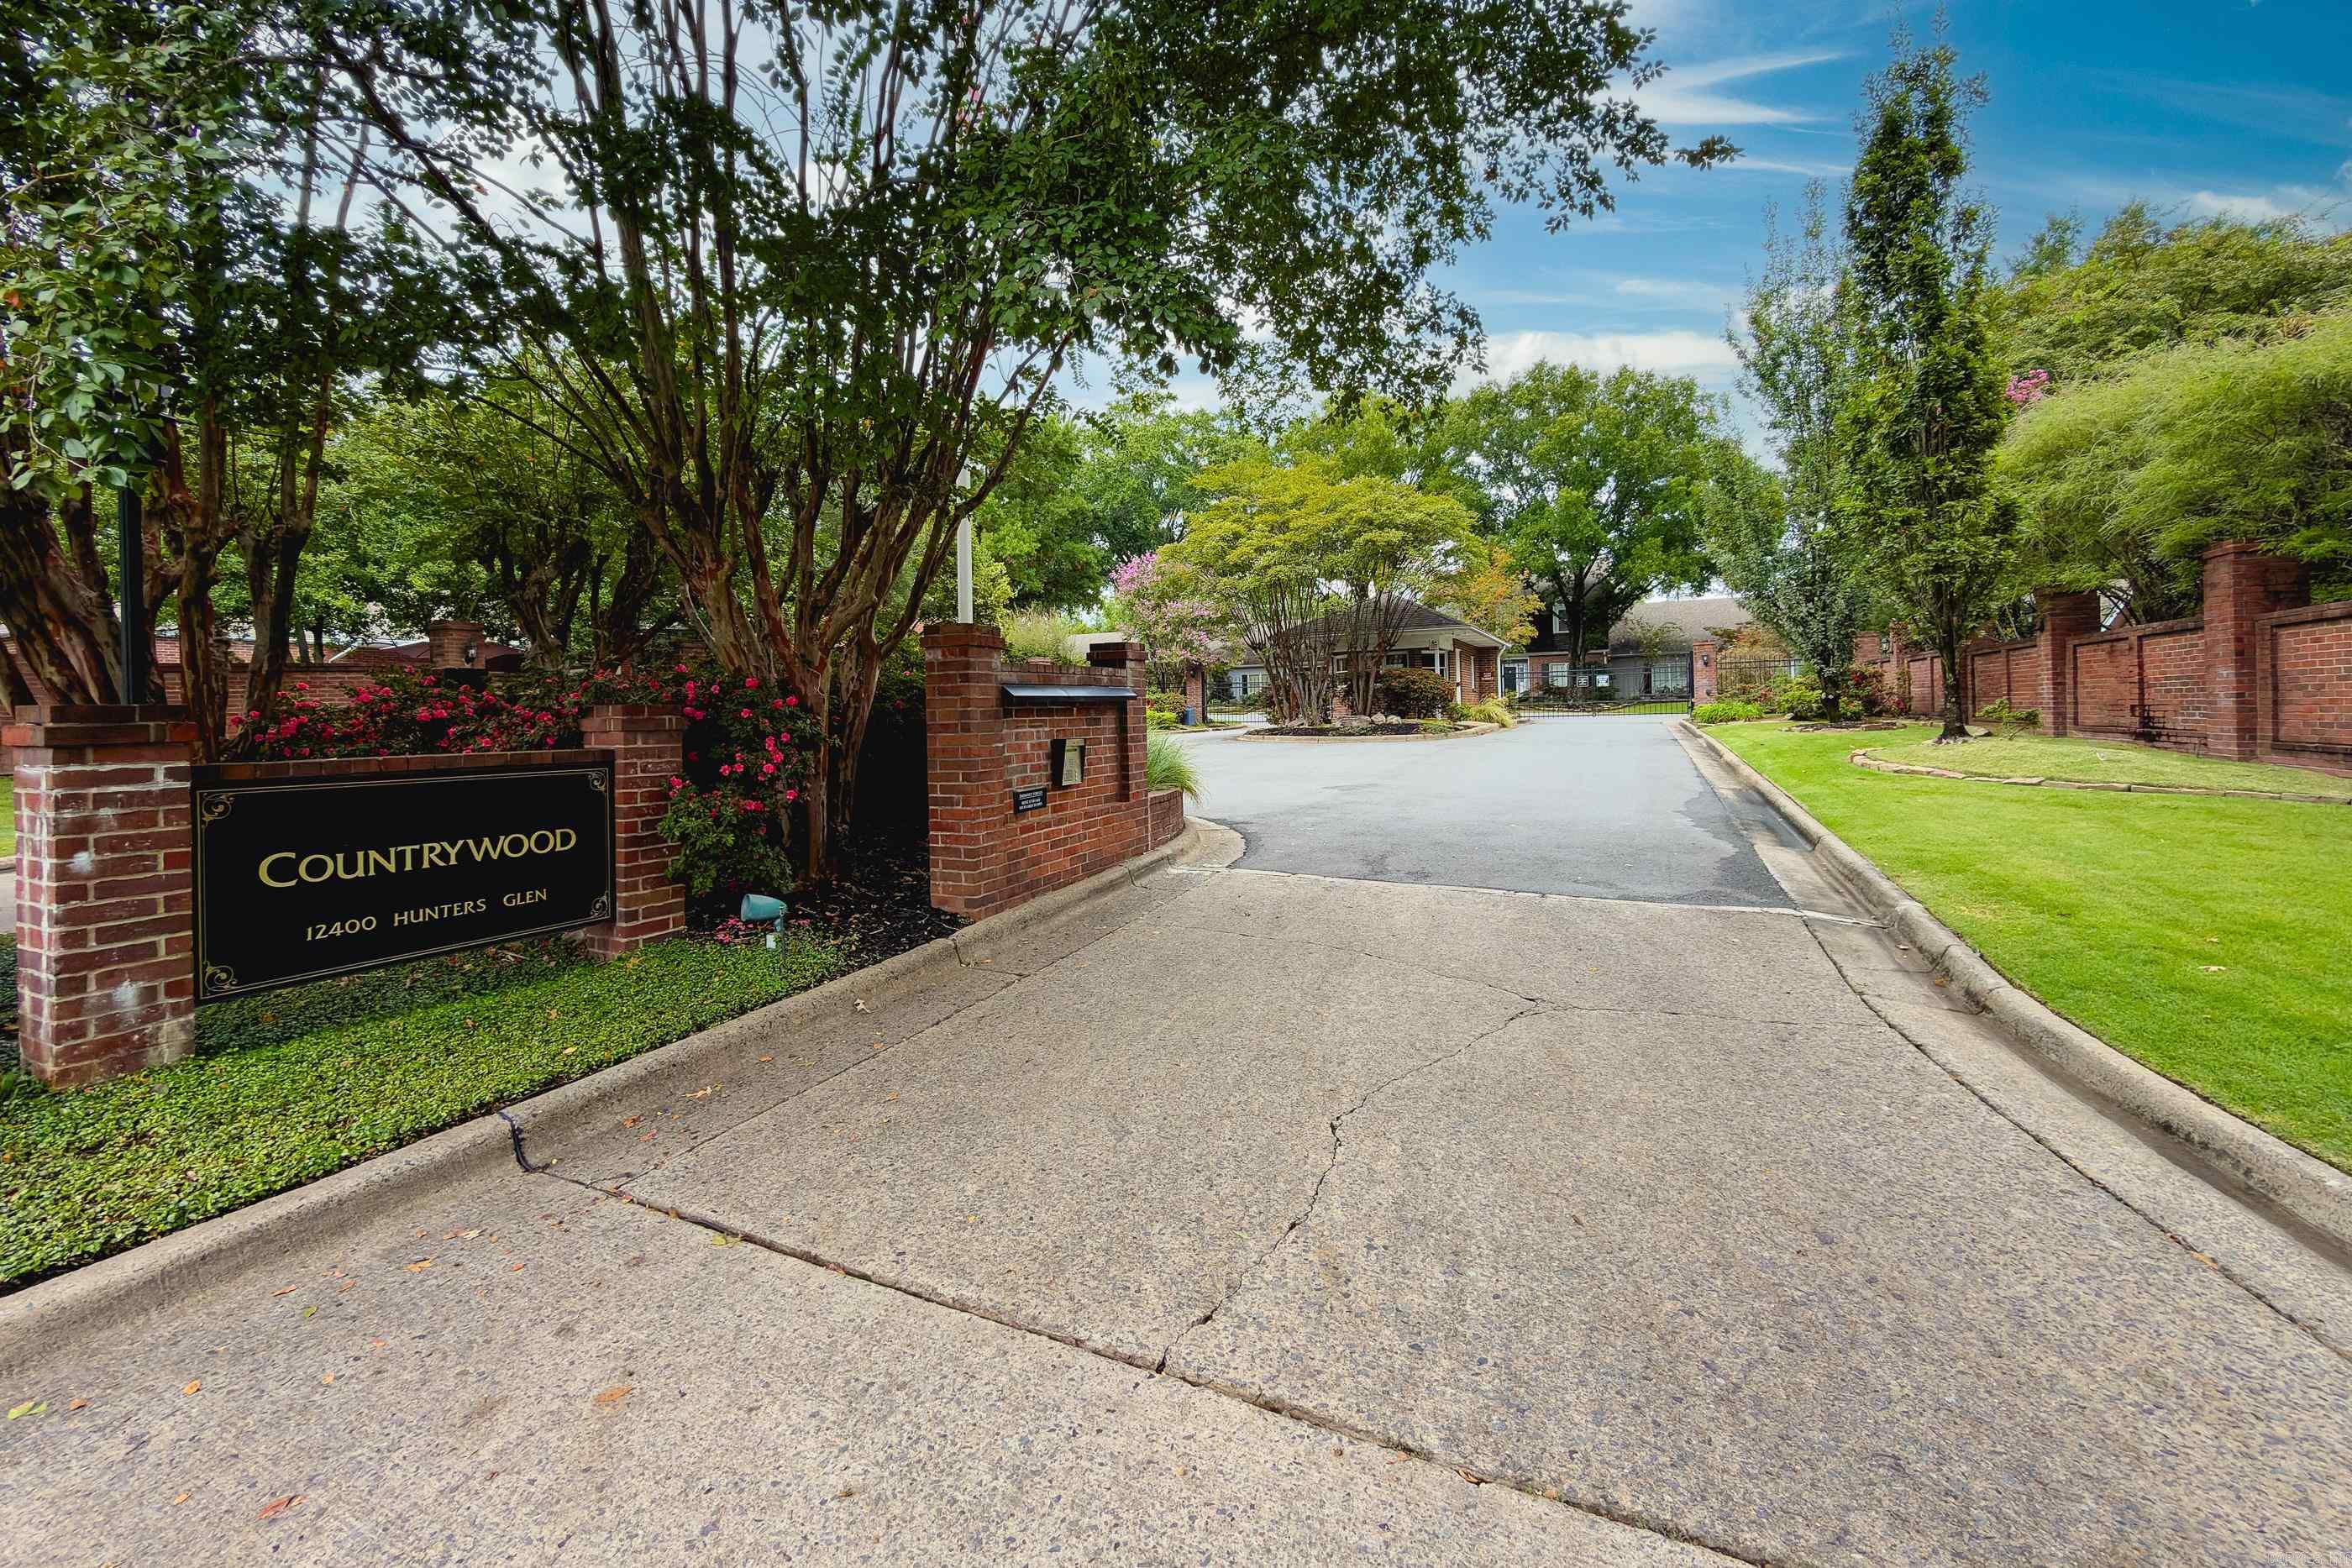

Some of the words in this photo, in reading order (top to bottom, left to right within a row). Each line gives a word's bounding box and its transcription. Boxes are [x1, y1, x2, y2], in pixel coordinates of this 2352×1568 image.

[258, 828, 577, 888] COUNTRYWOOD
[306, 915, 377, 941] 12400
[393, 898, 486, 927] HUNTERS
[502, 888, 547, 907] GLEN
